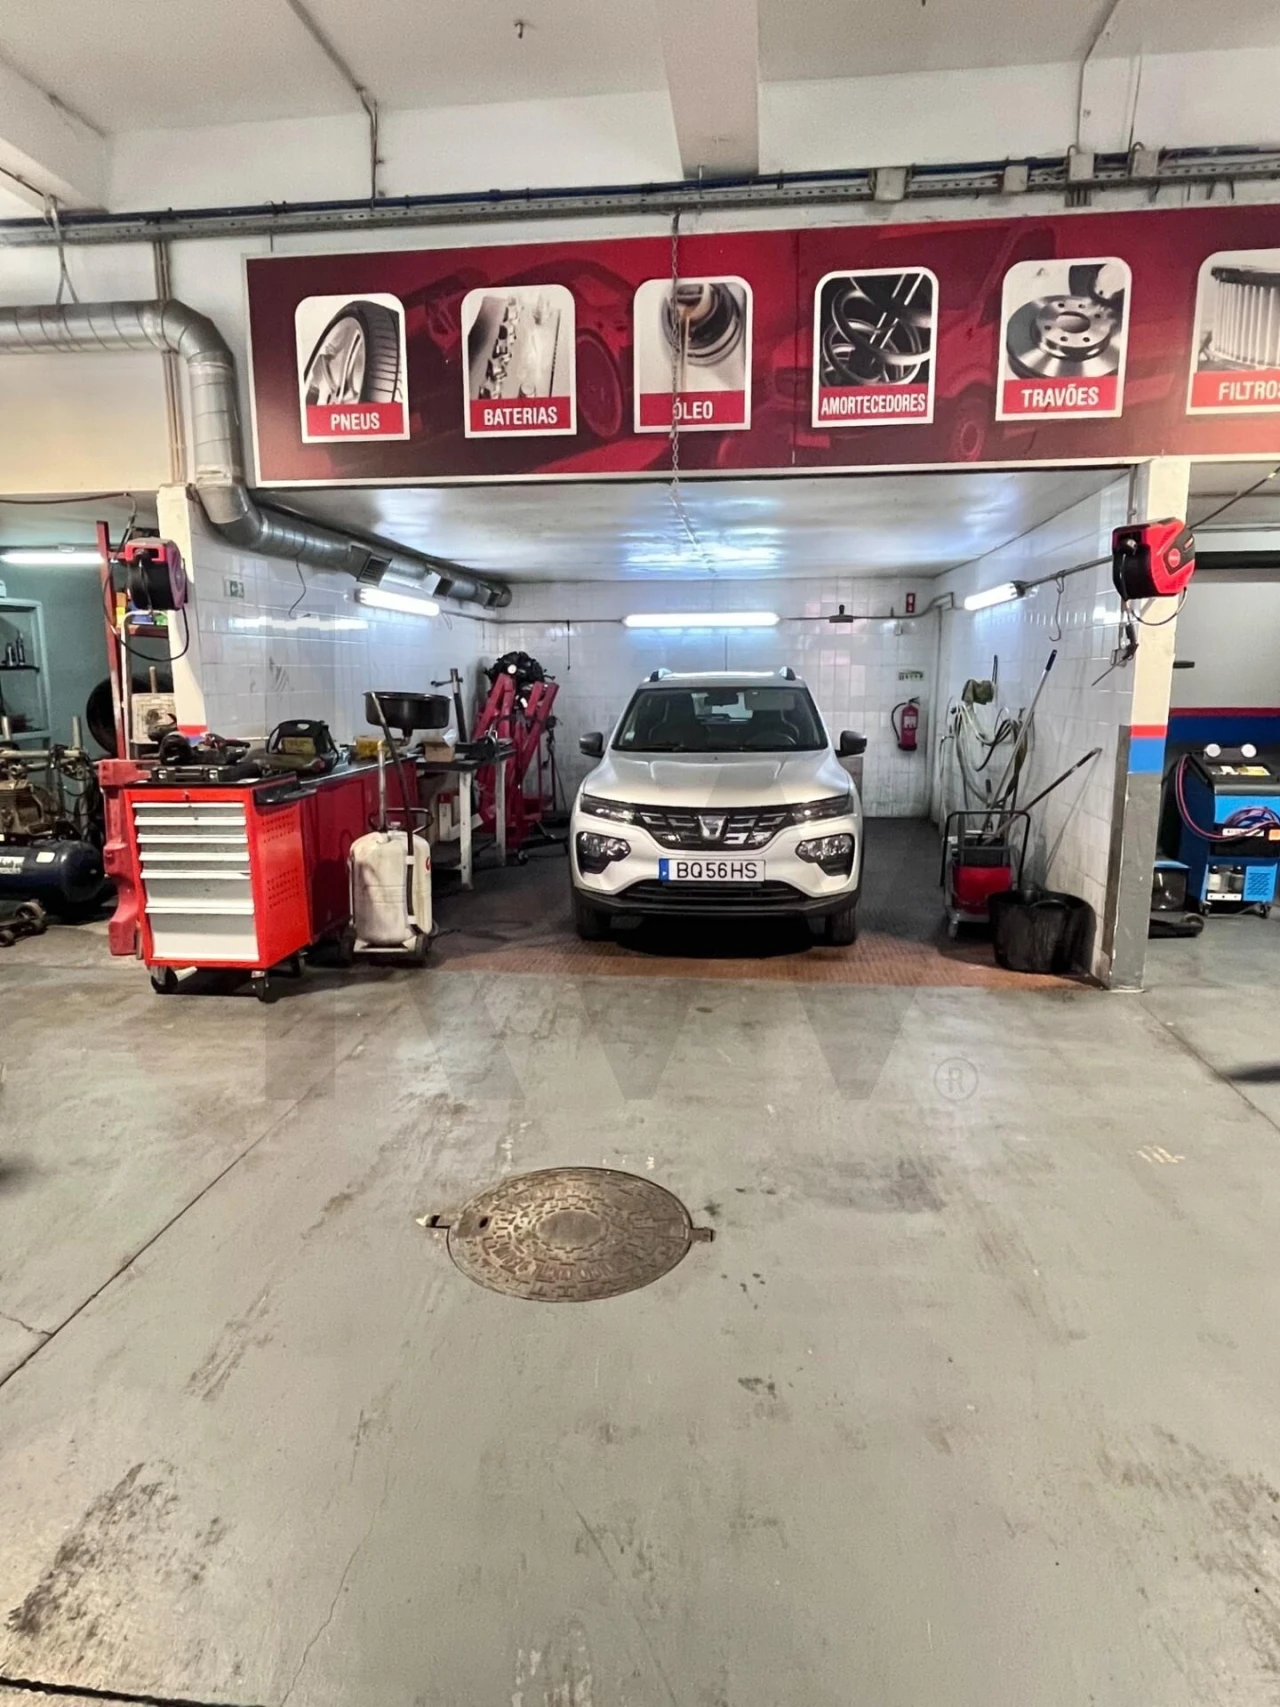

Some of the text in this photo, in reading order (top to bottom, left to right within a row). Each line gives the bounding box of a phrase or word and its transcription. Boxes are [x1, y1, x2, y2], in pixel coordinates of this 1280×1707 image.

[1021, 382, 1100, 408] TRAVÕES
[1218, 379, 1280, 401] FILTRO
[672, 397, 713, 420] ÓLEO
[820, 393, 926, 416] AMORTECEDORES
[330, 412, 380, 431] PNEUS
[483, 406, 558, 426] BATERIAS
